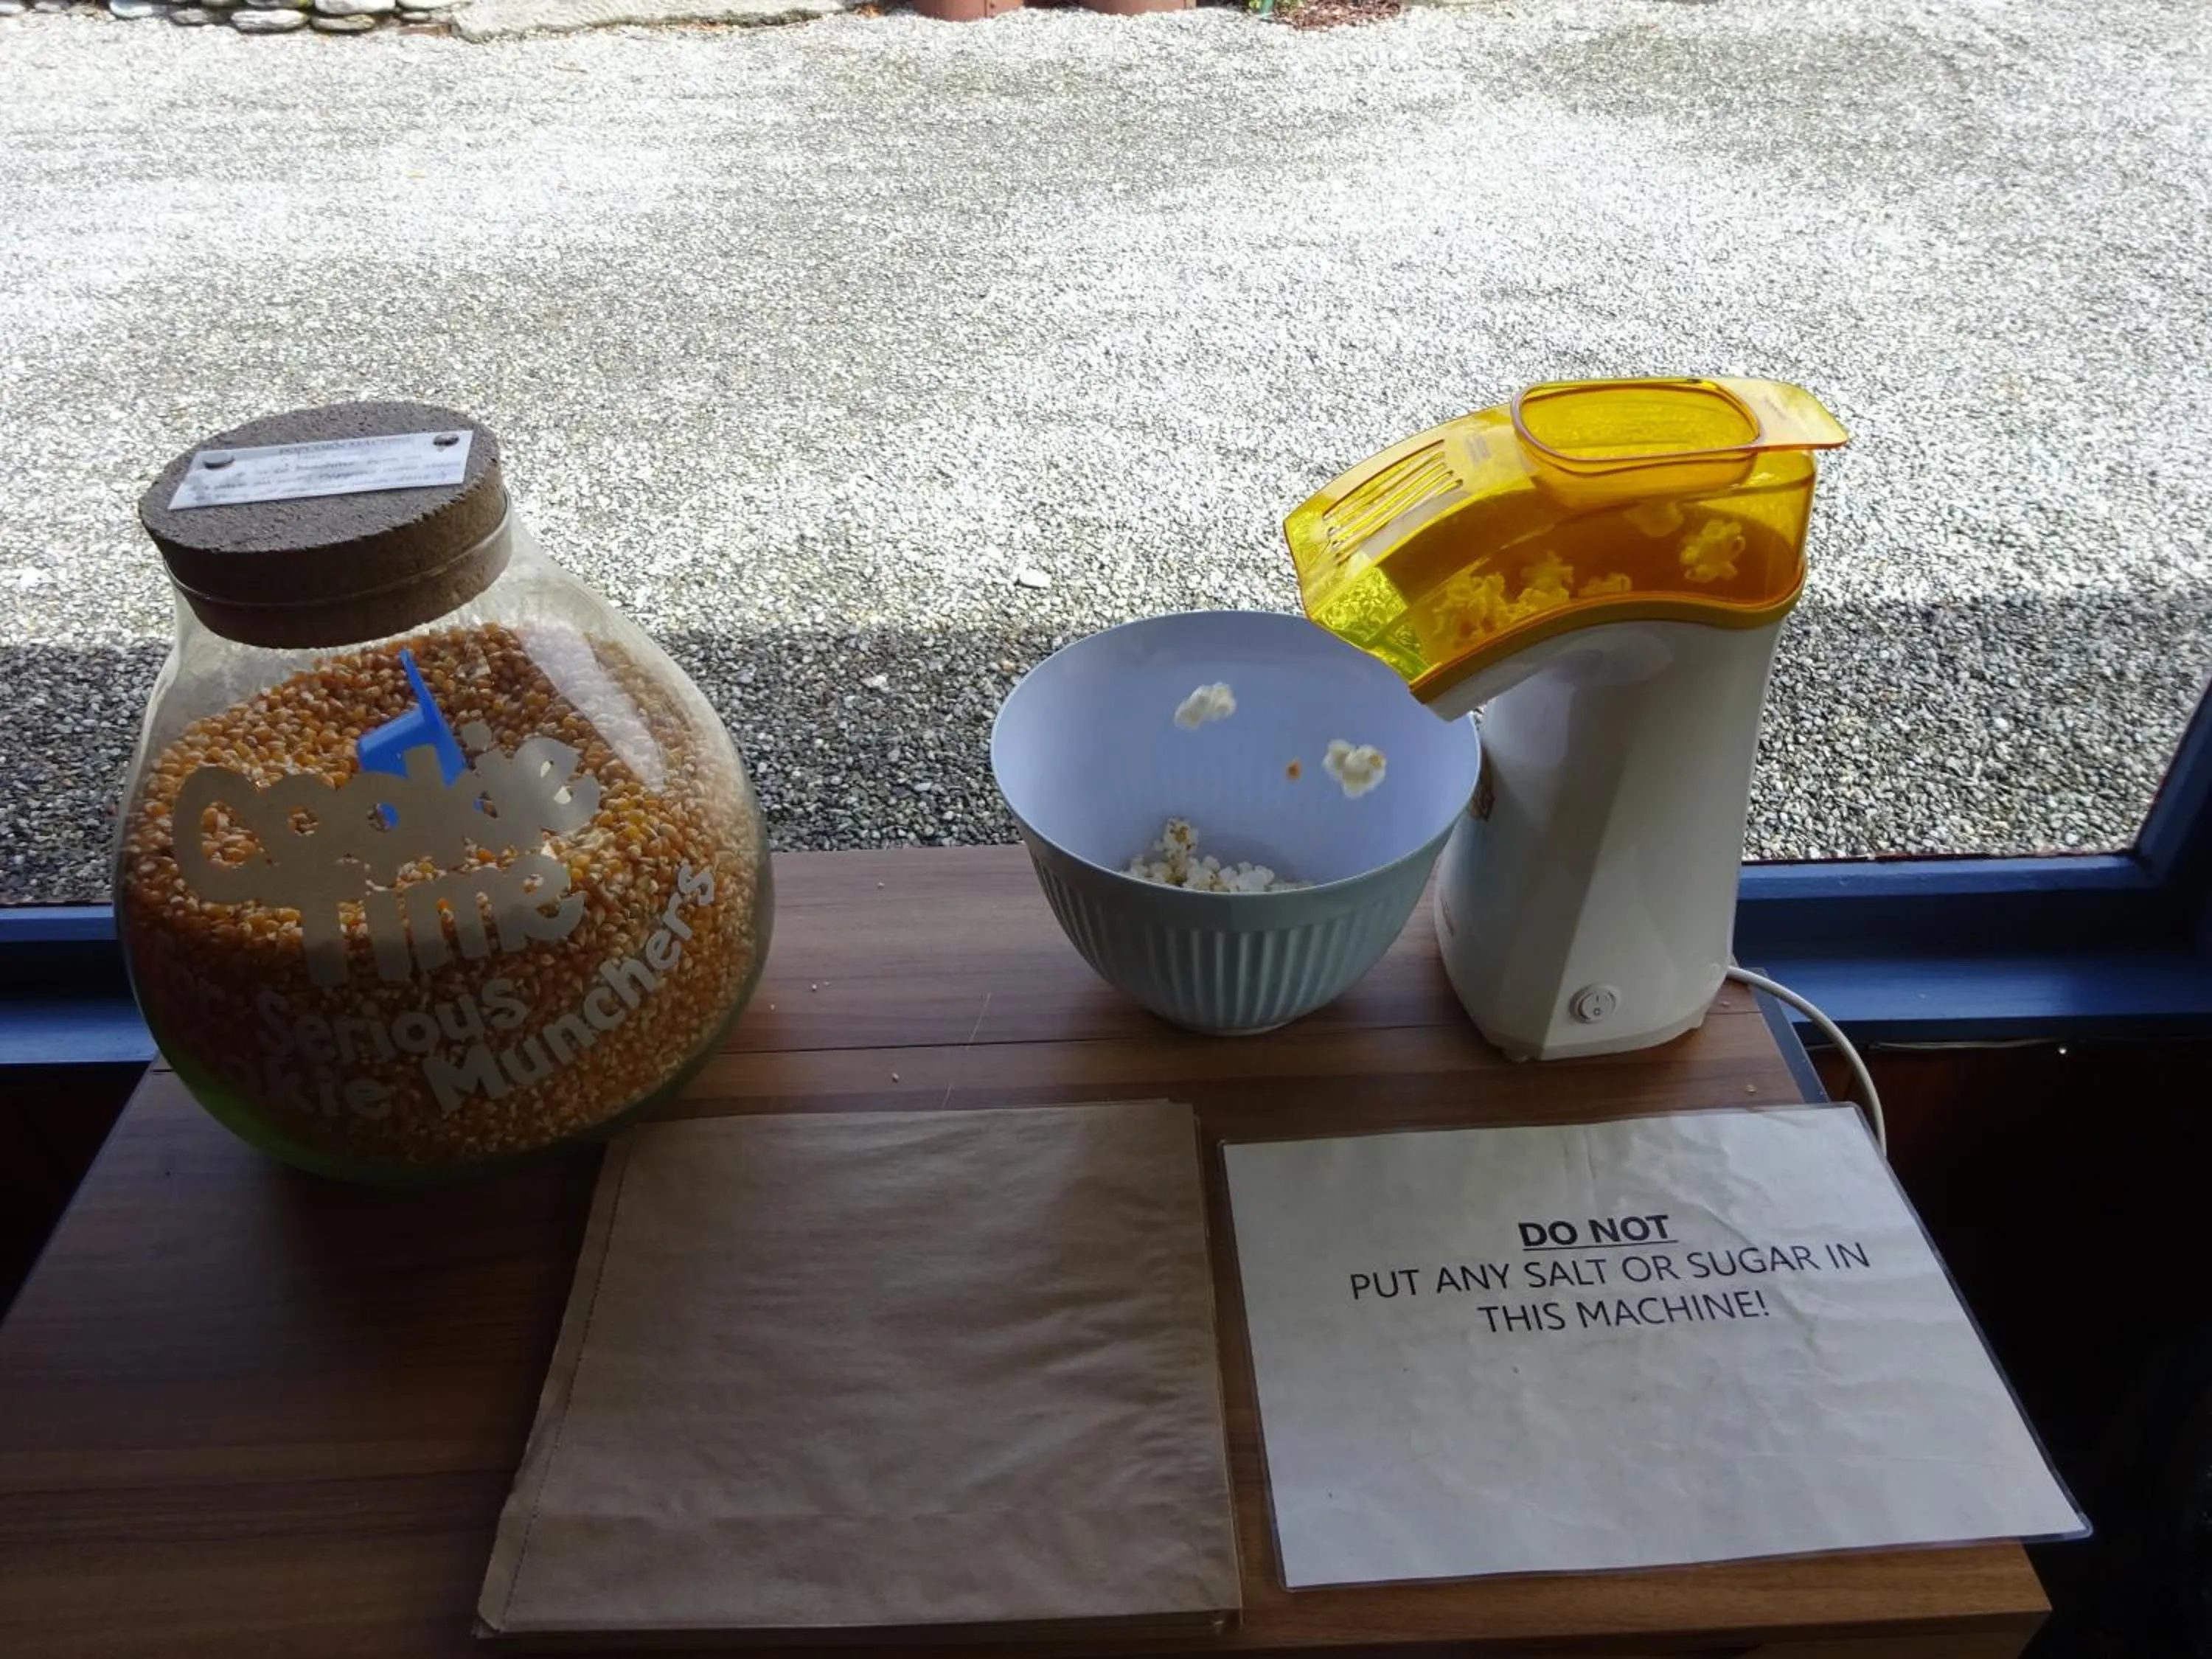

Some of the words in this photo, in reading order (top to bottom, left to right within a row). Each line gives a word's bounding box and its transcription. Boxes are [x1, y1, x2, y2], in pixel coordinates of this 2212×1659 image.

[173, 720, 602, 907] Cookie
[288, 853, 586, 987] Time
[256, 976, 531, 1065] Serious
[422, 861, 717, 1114] Munchers
[1350, 1268, 1420, 1301] PUT
[1436, 1263, 1510, 1294] ANY
[1523, 1259, 1607, 1288] SALT
[1621, 1255, 1681, 1283] OR
[1686, 1245, 1821, 1279] SUGAR
[1824, 1241, 1871, 1270] IN
[1517, 1220, 1578, 1248] DO
[1587, 1214, 1669, 1244] NOT
[1476, 1302, 1566, 1333] THIS
[1576, 1289, 1771, 1329] MACHINE!
